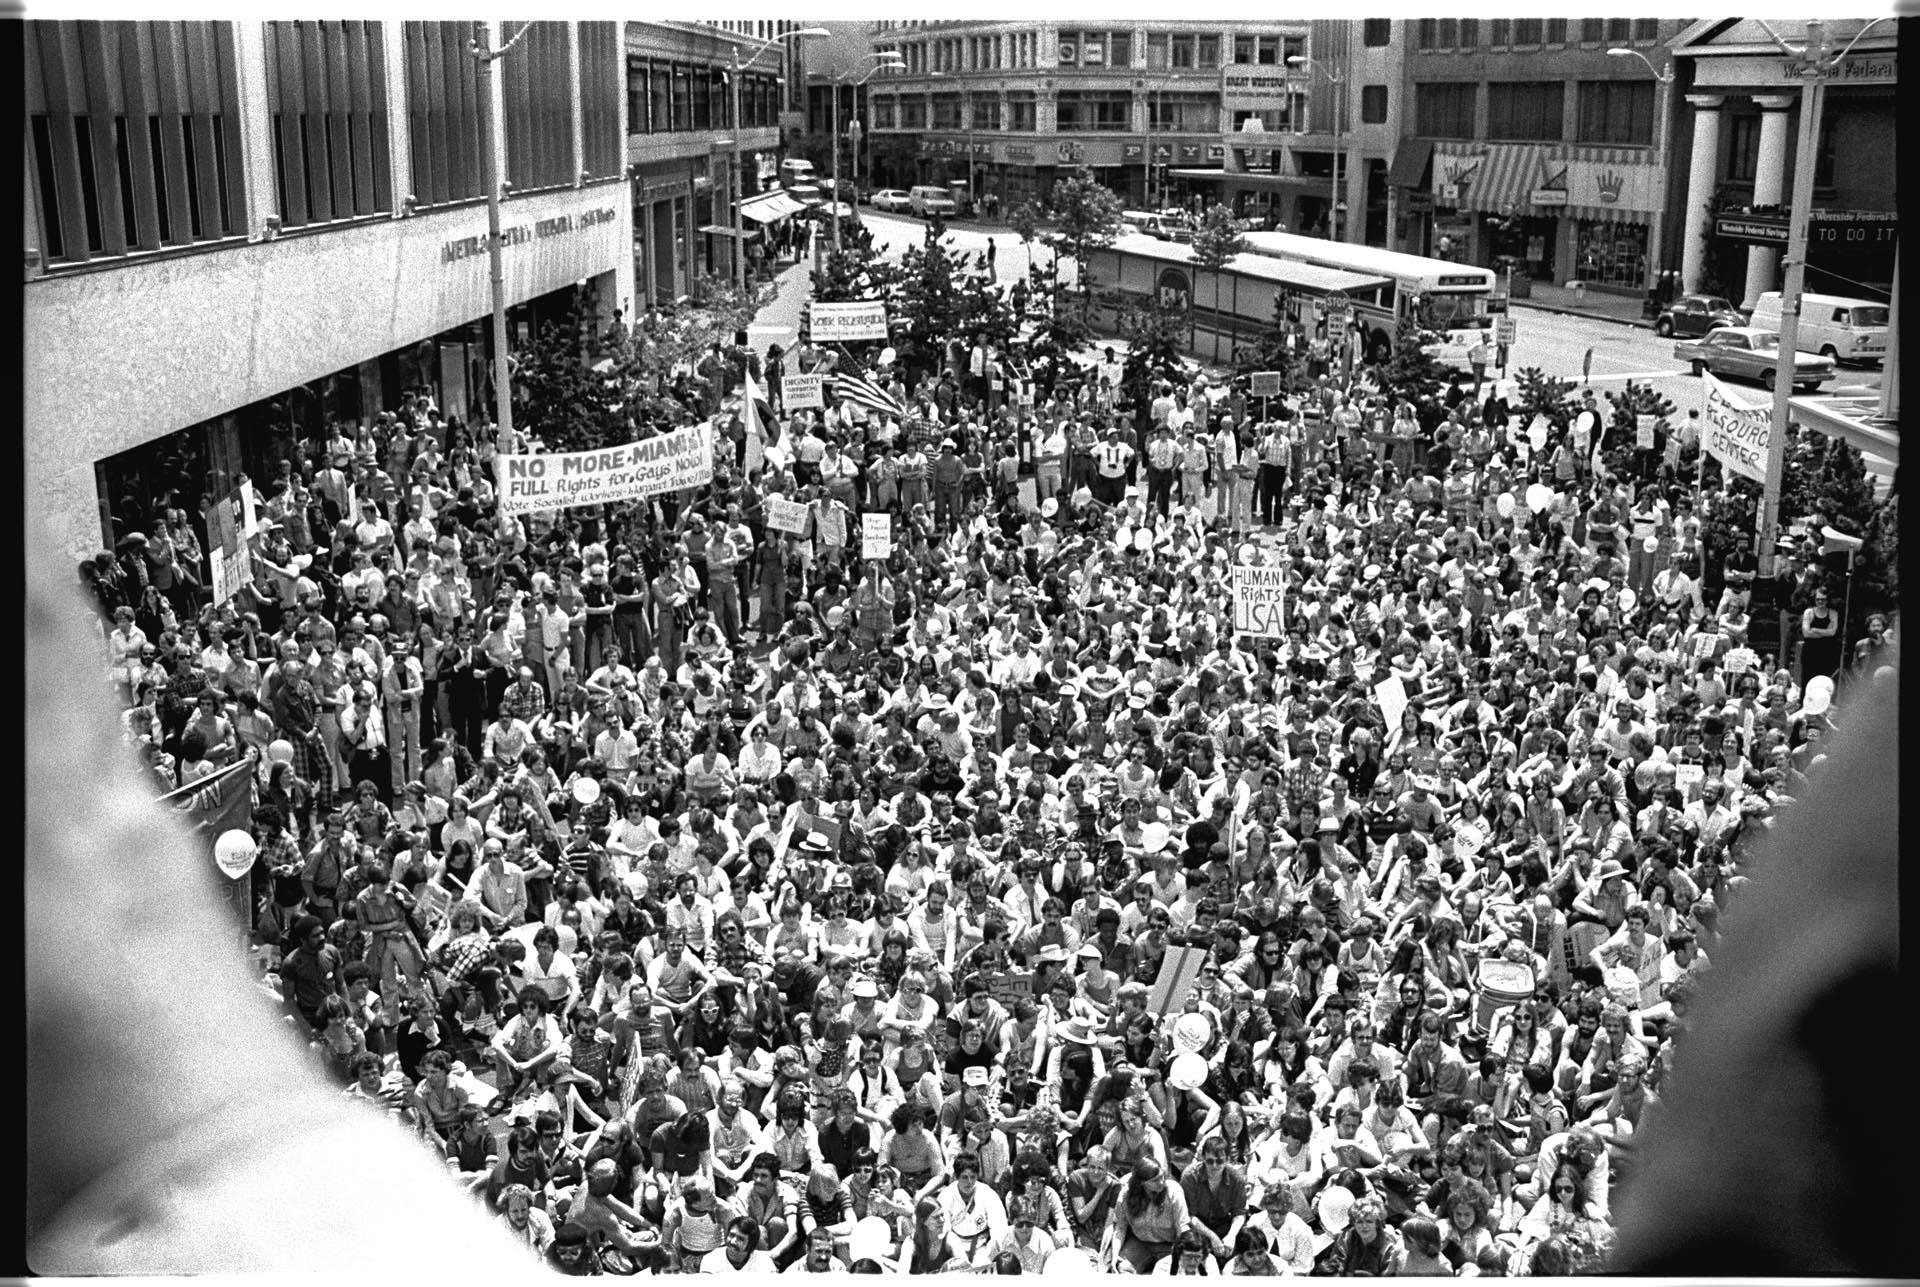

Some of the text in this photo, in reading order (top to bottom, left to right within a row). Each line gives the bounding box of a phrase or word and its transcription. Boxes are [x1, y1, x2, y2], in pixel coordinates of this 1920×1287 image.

[1819, 228, 1895, 241] TO DO IT
[1327, 296, 1347, 307] STOP
[785, 377, 819, 386] DIGNITY
[1712, 431, 1761, 468] CENTER
[509, 458, 546, 478] NO
[562, 450, 625, 475] MORE
[510, 480, 549, 497] FULL
[556, 477, 601, 495] Rights
[503, 501, 530, 512] Vote
[533, 494, 577, 510] Socialist
[1234, 569, 1280, 586] HUMAN
[1234, 601, 1283, 636] USA
